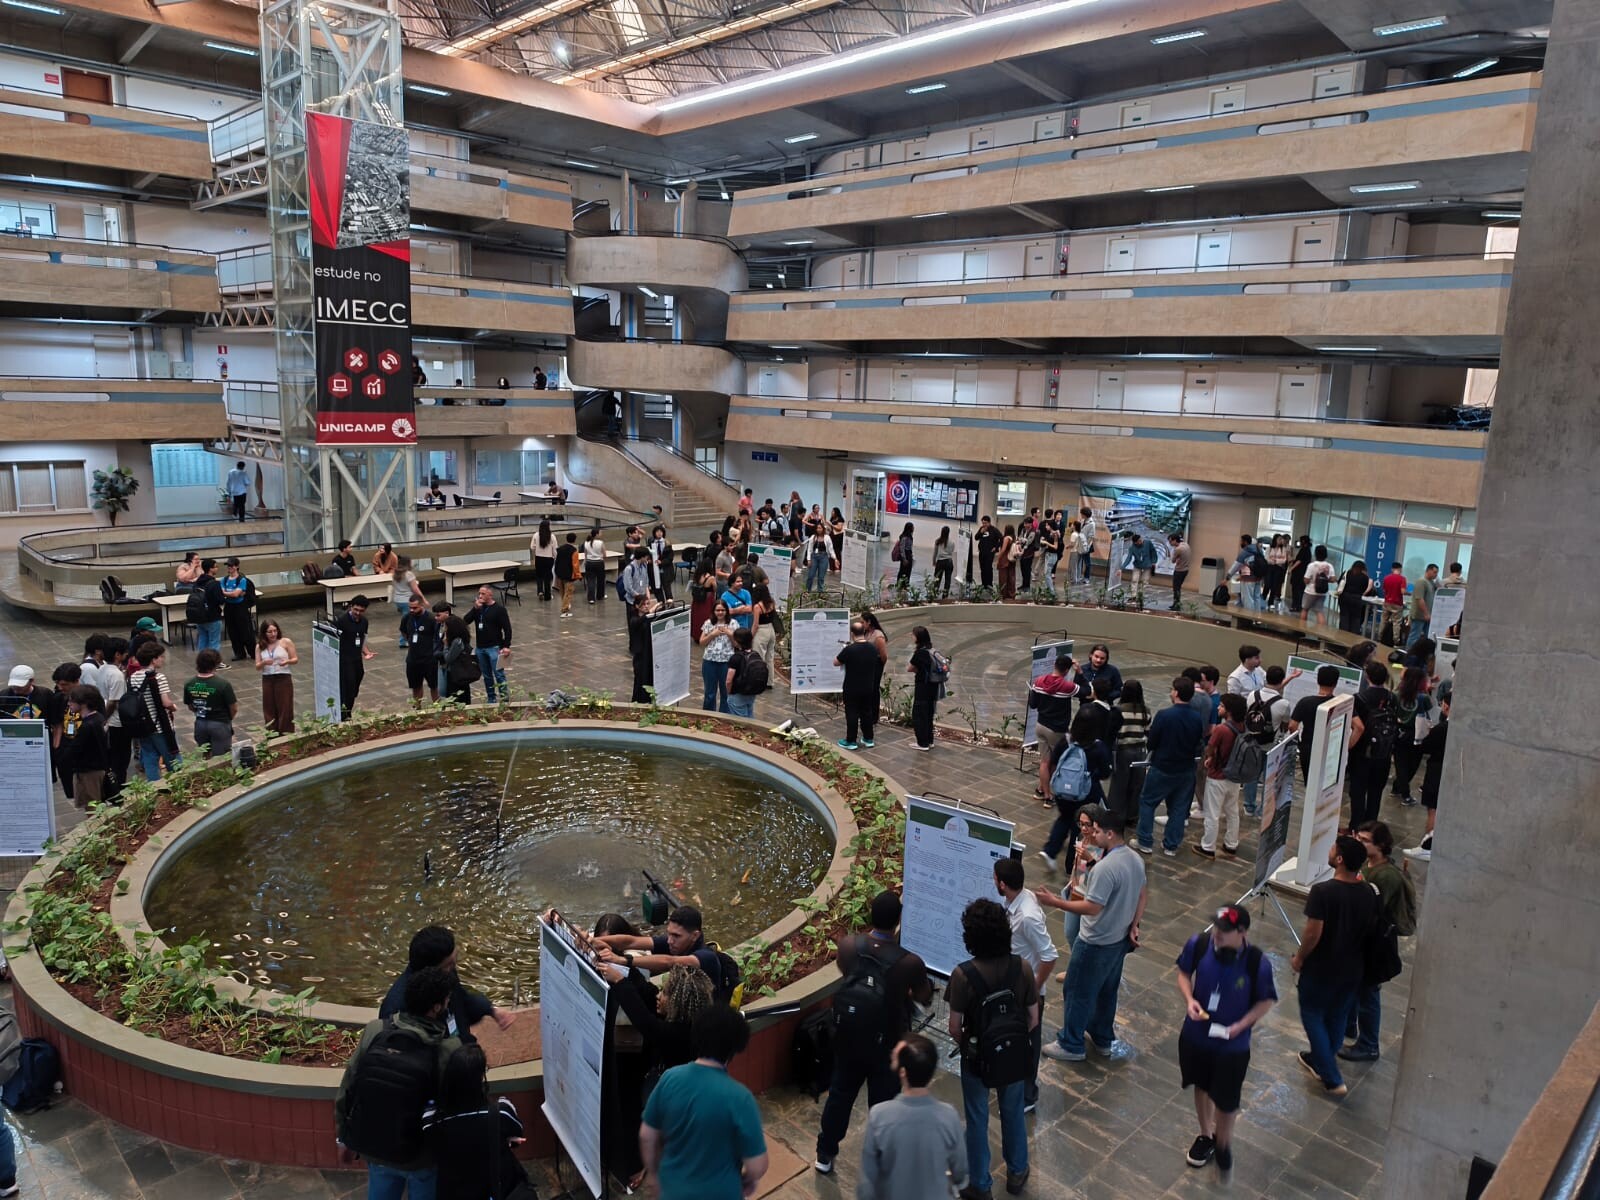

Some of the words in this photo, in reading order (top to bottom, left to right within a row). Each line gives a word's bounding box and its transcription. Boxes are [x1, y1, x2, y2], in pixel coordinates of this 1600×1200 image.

[315, 266, 360, 280] estude
[364, 272, 381, 282] no
[317, 296, 407, 323] IMECC
[319, 423, 386, 432] UNICAMP
[1373, 531, 1386, 588] AUDITÓ
